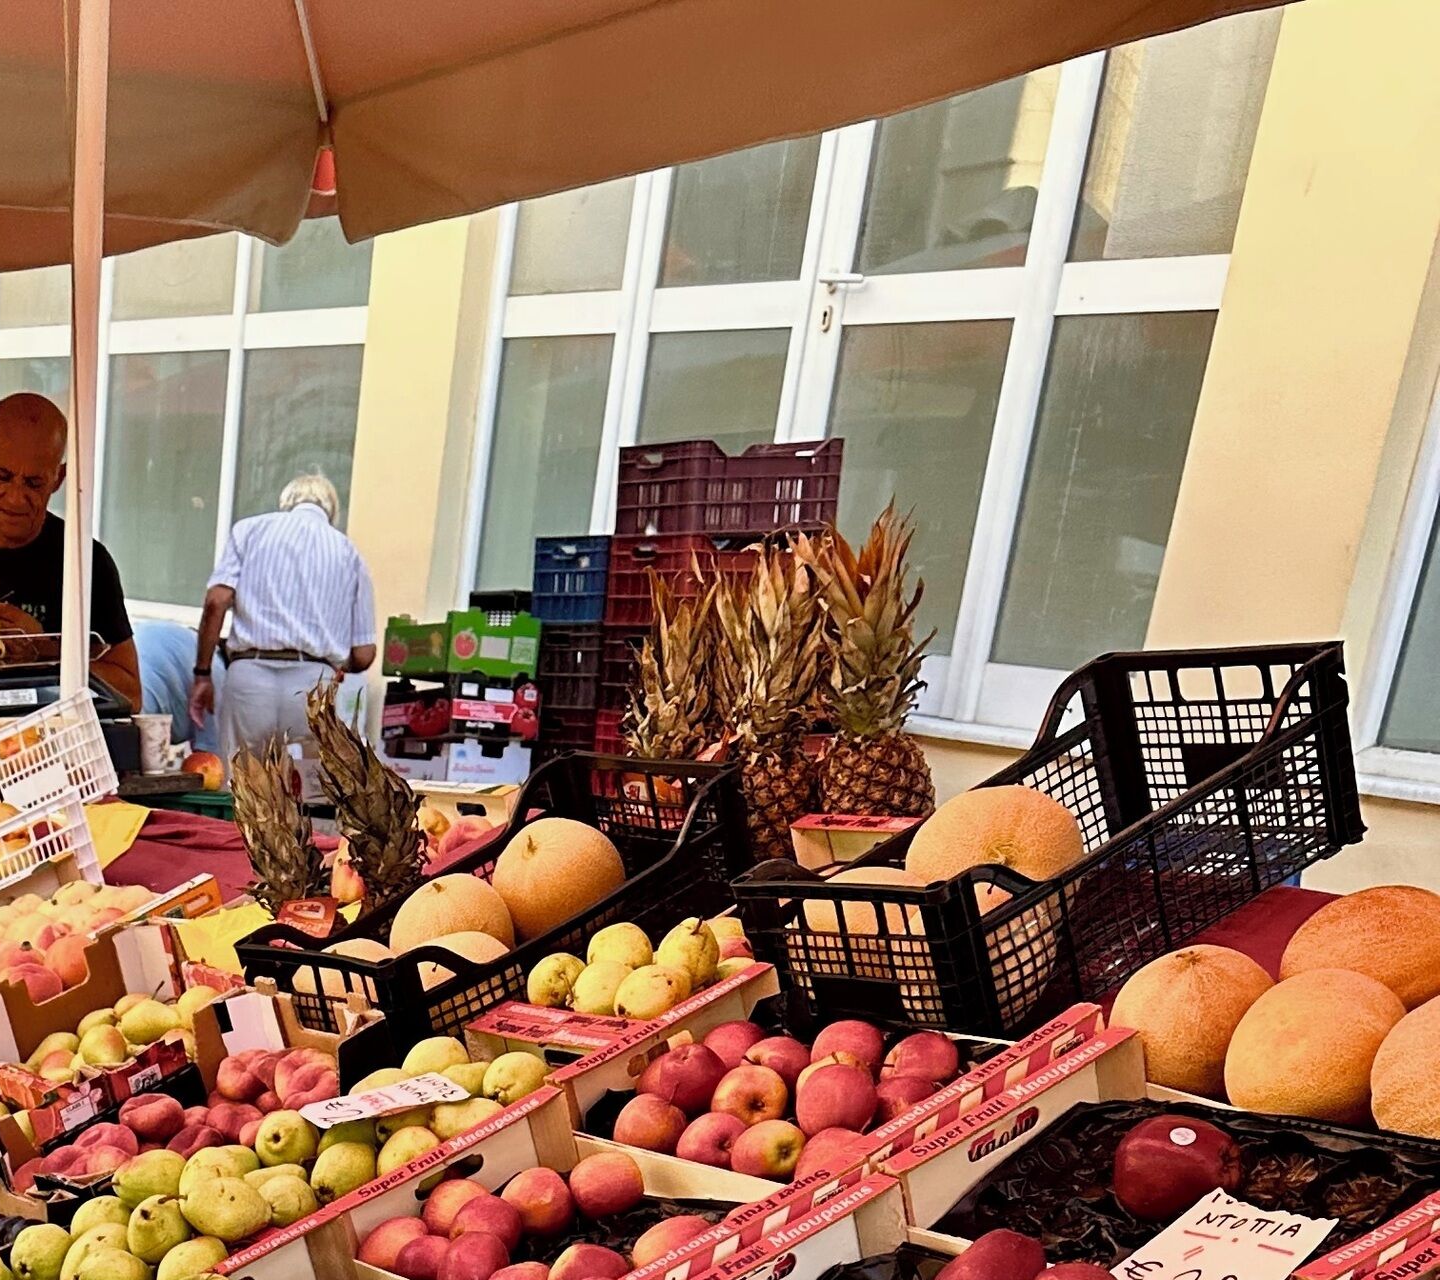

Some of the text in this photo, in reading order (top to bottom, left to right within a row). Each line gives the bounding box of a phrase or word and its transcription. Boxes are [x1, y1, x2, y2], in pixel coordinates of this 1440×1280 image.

[575, 1043, 614, 1070] Super
[624, 1022, 660, 1046] Fruit
[1018, 1020, 1068, 1052] Super
[975, 1053, 1018, 1082] Fruit
[910, 1126, 963, 1158] Super
[962, 1099, 1007, 1128] Fruit
[358, 1170, 405, 1198] Super
[409, 1149, 447, 1174] Fruit
[779, 1169, 831, 1199] Super
[733, 1200, 778, 1226] Fruit
[719, 1246, 766, 1275] Fruit
